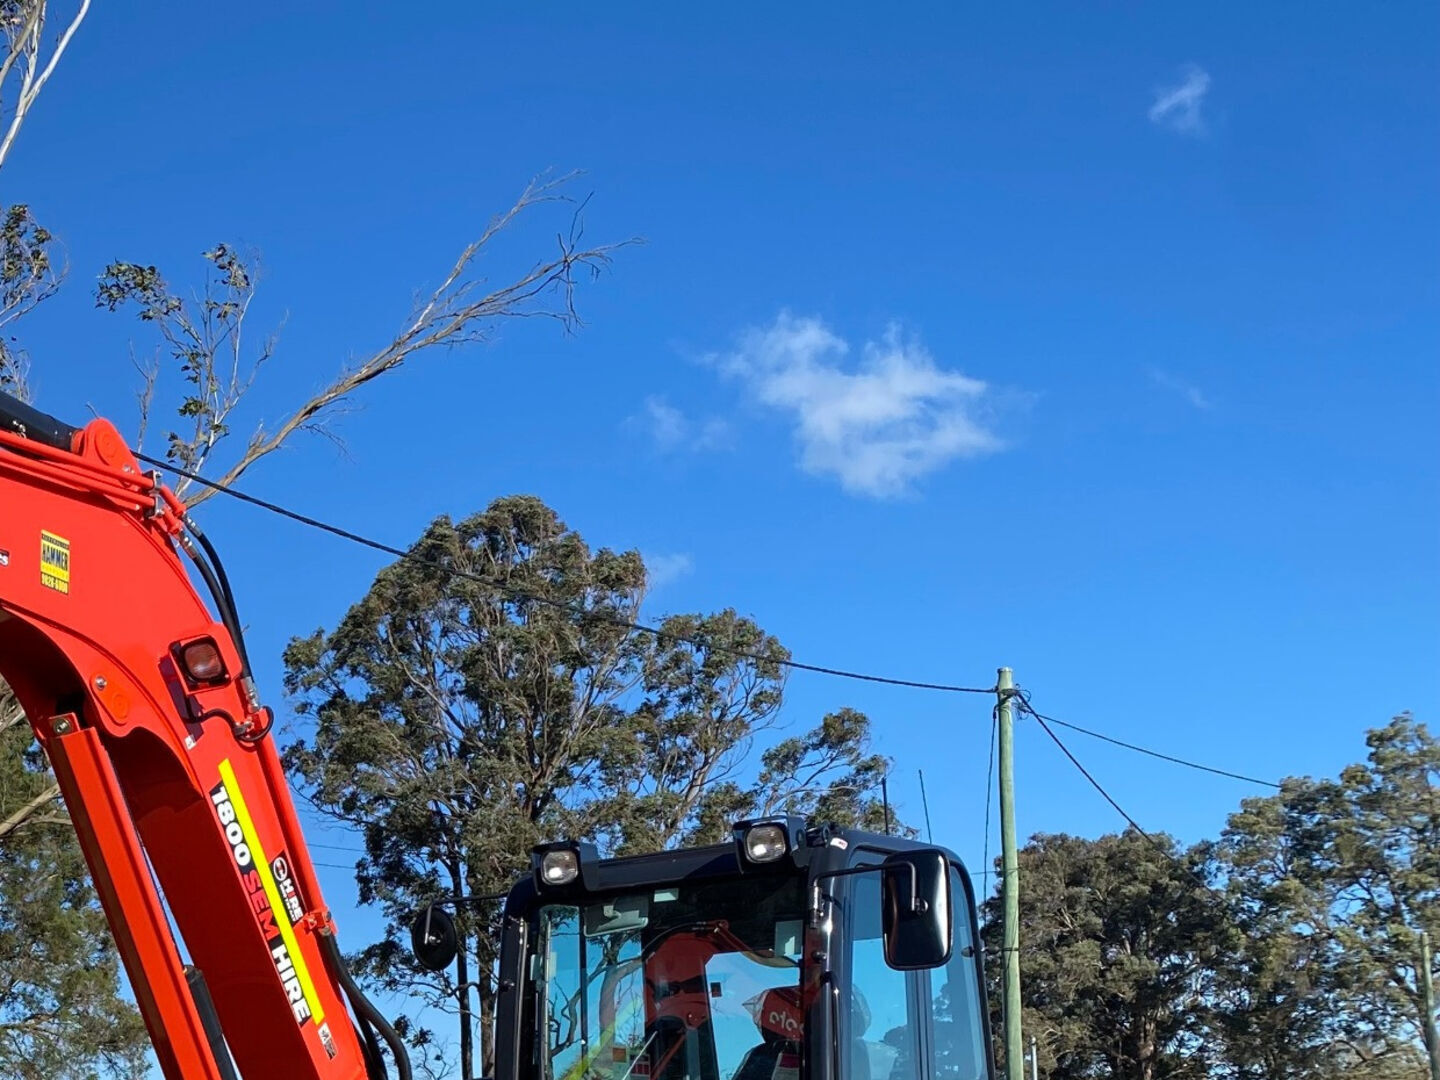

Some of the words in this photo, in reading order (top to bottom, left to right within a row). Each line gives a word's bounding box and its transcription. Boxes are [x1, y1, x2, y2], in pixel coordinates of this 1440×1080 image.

[43, 543, 68, 572] HAMMER
[211, 784, 252, 867] 1800
[243, 868, 281, 941] SEM
[271, 943, 313, 1027] HIRE
